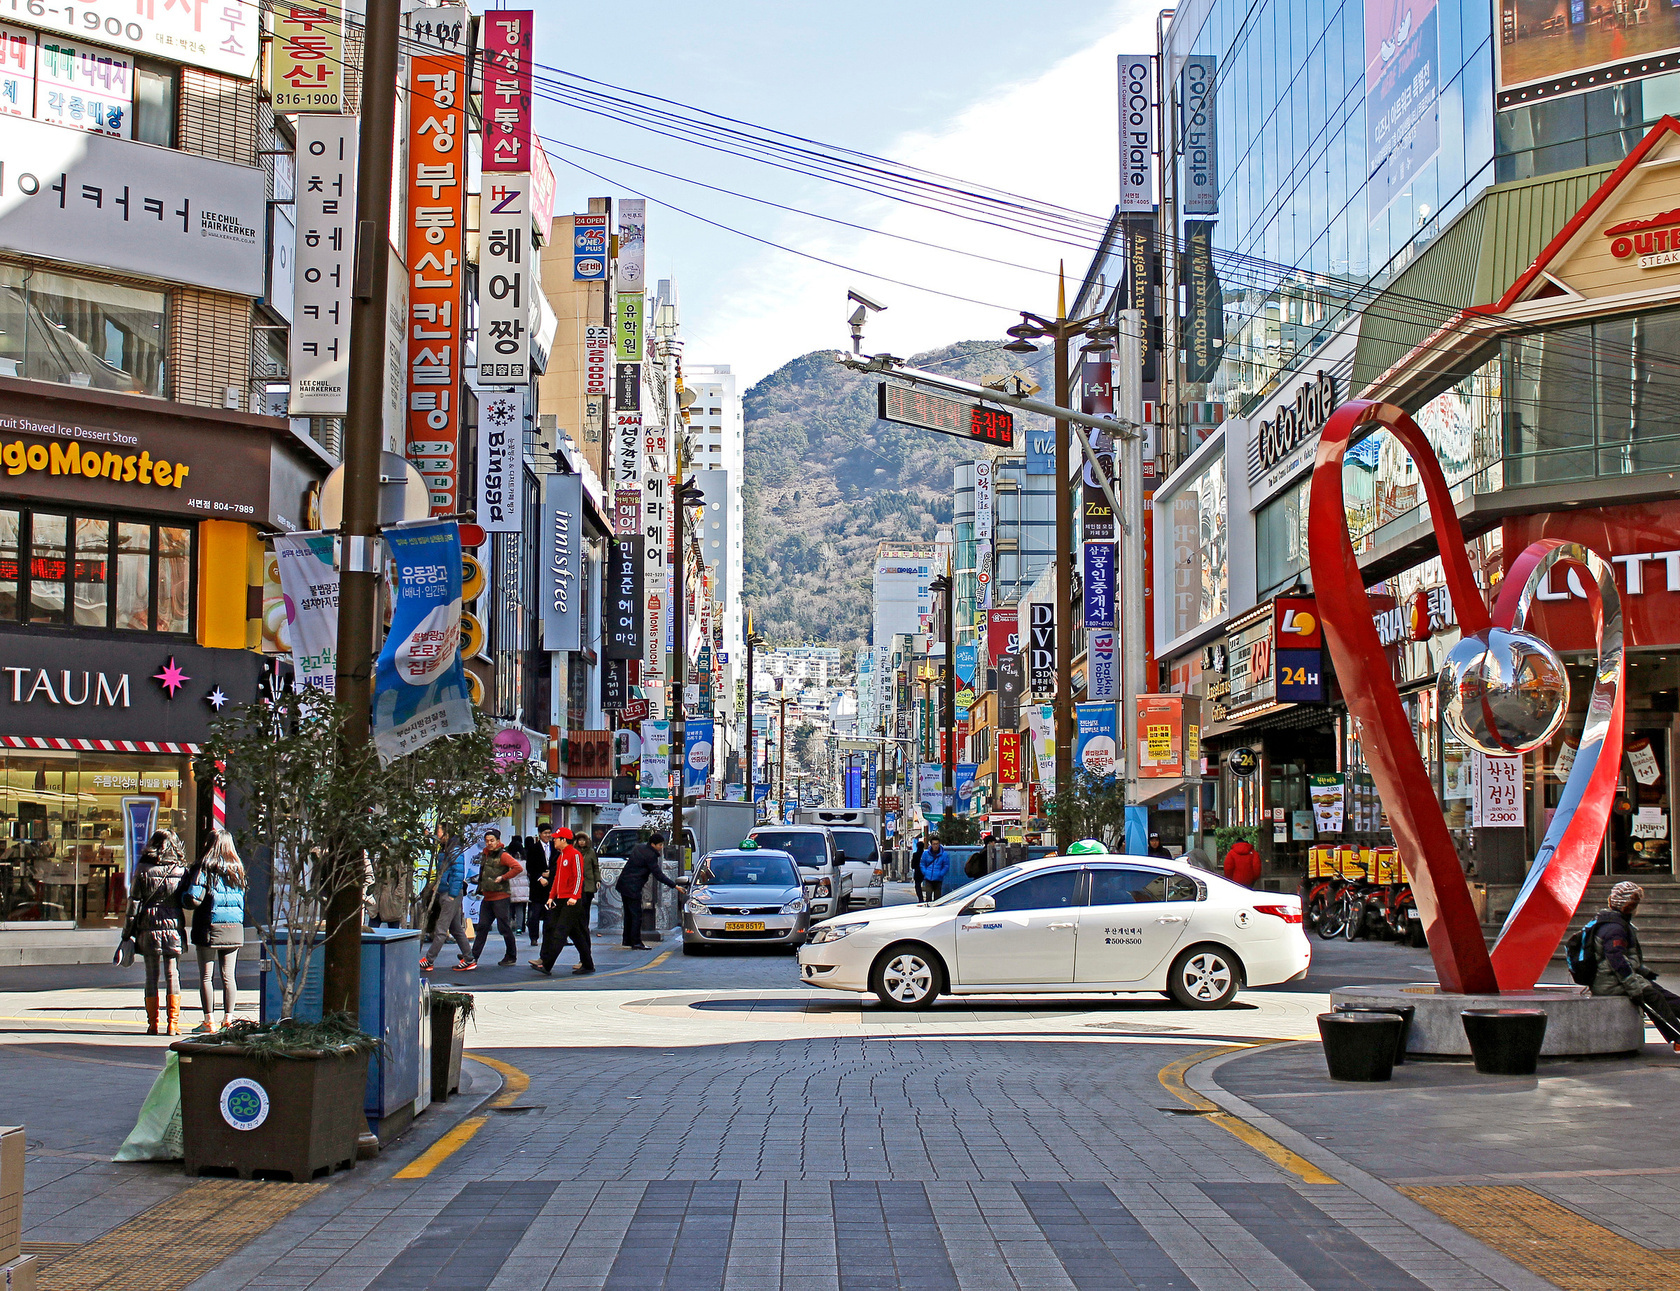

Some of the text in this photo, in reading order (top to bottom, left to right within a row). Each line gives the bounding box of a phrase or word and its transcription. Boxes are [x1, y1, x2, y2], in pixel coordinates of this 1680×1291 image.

[282, 7, 334, 88] 부동산
[276, 93, 338, 105] 816-1900
[48, 92, 124, 129] 각종매장
[1121, 109, 1129, 139] Restaurant
[1128, 63, 1149, 187] CoCo Plate
[202, 211, 217, 221] LEE
[202, 220, 256, 238] HAIRKERKER
[579, 262, 601, 271] 담배
[1641, 253, 1680, 268] STEAK
[488, 229, 524, 355] 헤어짱
[623, 304, 638, 354] 유학원
[481, 364, 524, 377] 美容室
[969, 408, 1013, 442] 동참합
[1258, 404, 1296, 470] CoCo
[1295, 369, 1334, 442] Plate
[19, 418, 56, 434] Shaved
[58, 424, 72, 437] Ice
[74, 426, 111, 442] Dessert
[112, 431, 138, 445] Store
[645, 428, 666, 436] K-1
[645, 437, 666, 452] 유학
[0, 441, 189, 488] goMonster
[485, 431, 505, 523] Bingga
[187, 498, 254, 514] 서면점 804-7989
[1086, 502, 1111, 516] ZONE
[646, 478, 664, 567] 헤라헤어
[550, 509, 575, 613] innisfree
[402, 565, 448, 585] 유동광고
[1089, 556, 1108, 621] 공인중개사
[1032, 605, 1053, 669] DVD
[300, 655, 322, 673] 걷고
[649, 638, 659, 668] TOUCH
[1103, 661, 1113, 695] baskin
[1001, 736, 1018, 781] 사격장
[93, 775, 138, 789] 주름인상의
[1487, 760, 1517, 782] 착한
[1637, 765, 1655, 778] 1+1
[31, 783, 61, 791] LEIGE
[1488, 785, 1517, 806] 점심
[1489, 813, 1517, 822] 2,900
[745, 923, 762, 931] 8517
